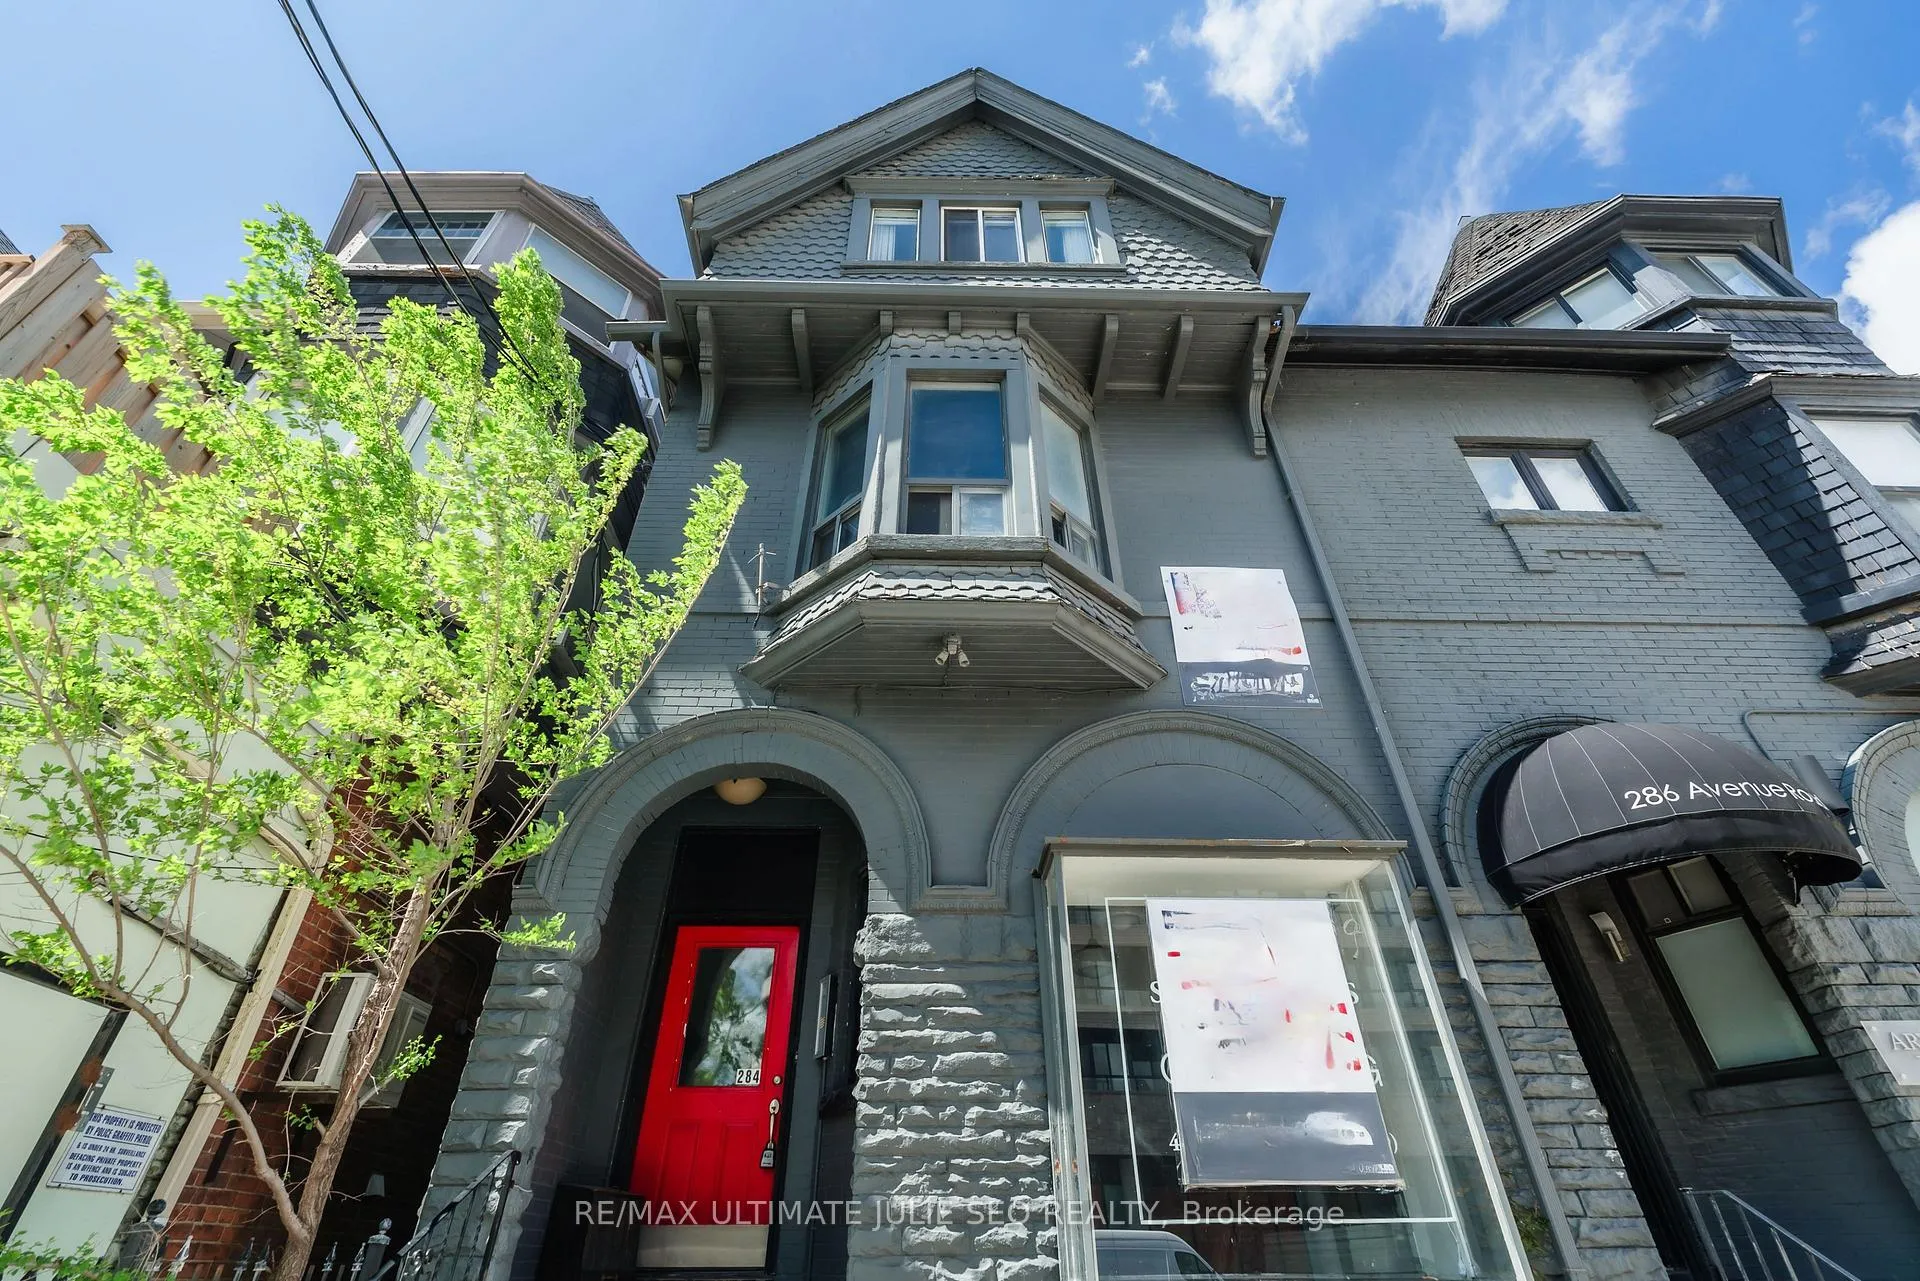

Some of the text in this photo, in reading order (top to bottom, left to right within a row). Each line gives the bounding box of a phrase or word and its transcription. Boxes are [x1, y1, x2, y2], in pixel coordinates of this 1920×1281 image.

[1624, 783, 1680, 810] 286
[1689, 780, 1787, 799] Avenue
[1889, 1031, 1920, 1050] AR
[737, 1069, 760, 1084] 284
[89, 1112, 162, 1133] THIS PROPERTY IS PROTECTED
[85, 1125, 152, 1145] BY POLICE GRAFFITI PATROL
[88, 1143, 103, 1152] UNDER
[117, 1147, 146, 1158] SURVEILLANCE
[69, 1152, 143, 1168] DEFACING PRIVATE PROPERTY
[66, 1162, 138, 1177] IS AN OFFENCE AND IS SUBJECT
[69, 1173, 123, 1186] TO PROSECUTION.
